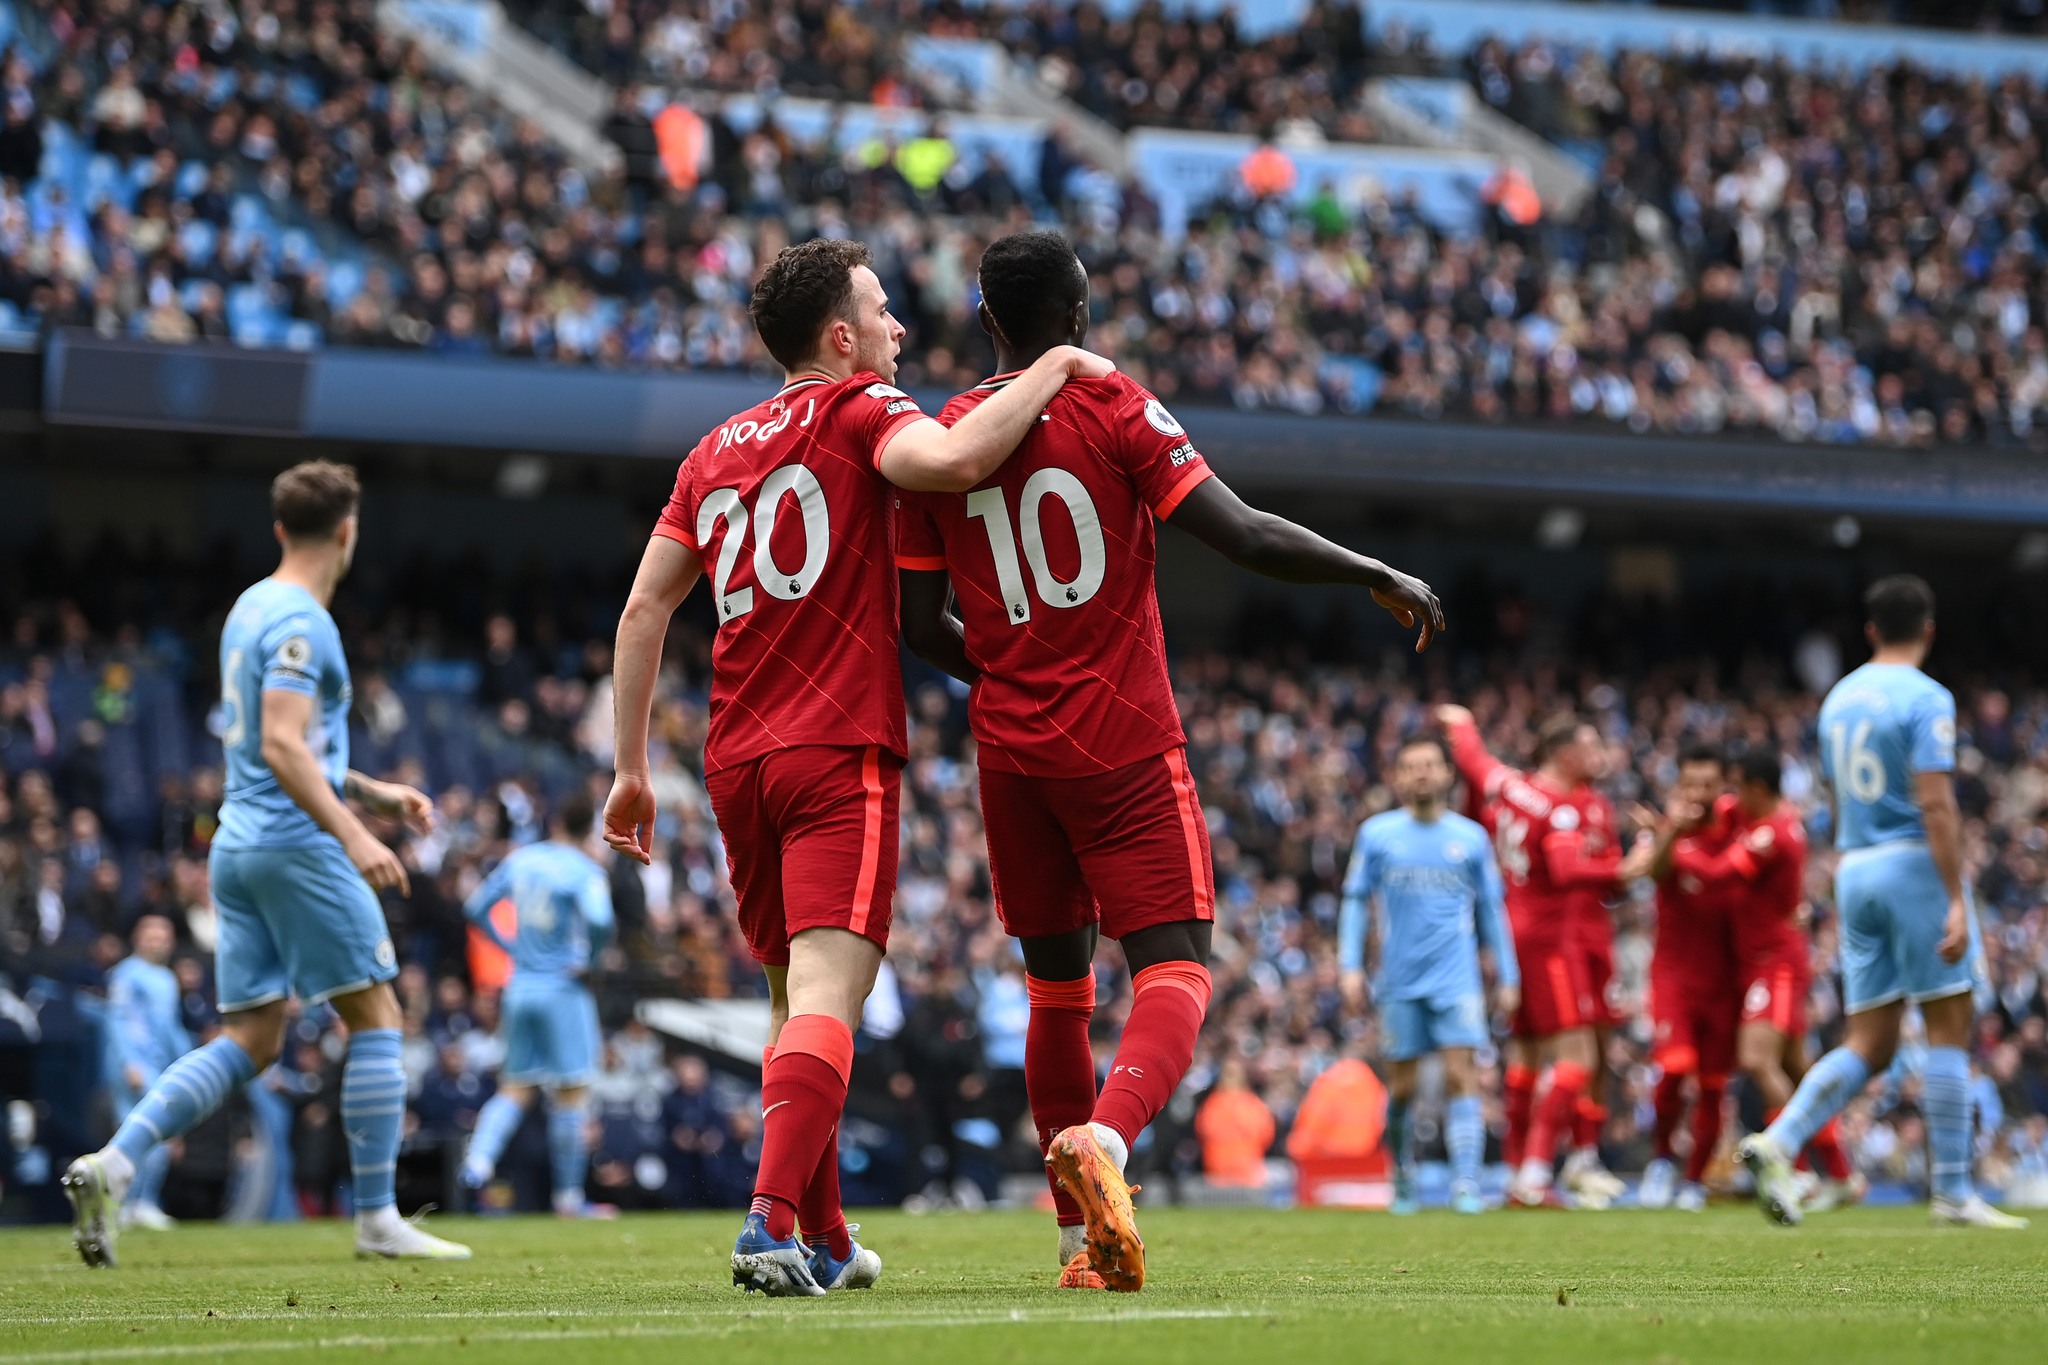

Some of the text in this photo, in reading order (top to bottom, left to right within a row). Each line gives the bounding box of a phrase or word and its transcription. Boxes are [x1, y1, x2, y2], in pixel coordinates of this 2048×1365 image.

[714, 398, 815, 456] DIOGO J
[1169, 448, 1183, 459] No
[696, 463, 830, 628] 20
[966, 466, 1106, 626] 10
[1831, 718, 1888, 805] 16
[1106, 1065, 1144, 1079] FC
[1037, 1127, 1060, 1143] LF
